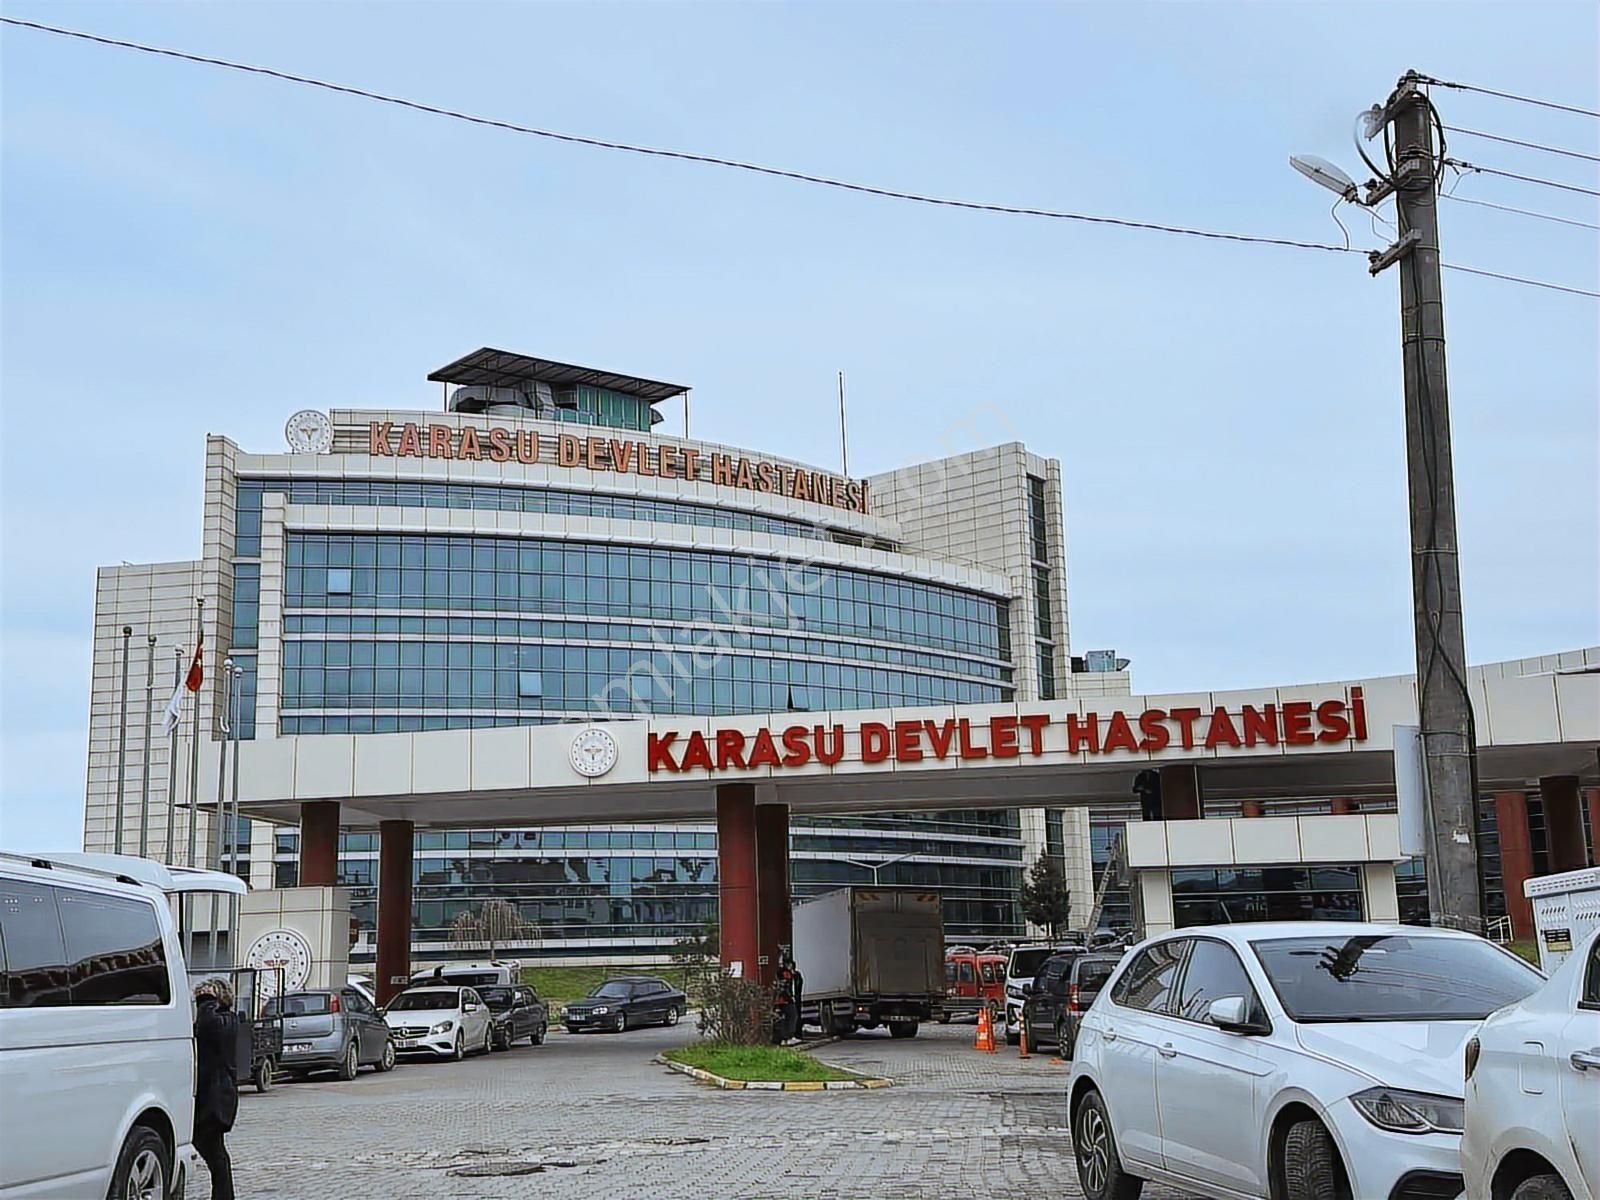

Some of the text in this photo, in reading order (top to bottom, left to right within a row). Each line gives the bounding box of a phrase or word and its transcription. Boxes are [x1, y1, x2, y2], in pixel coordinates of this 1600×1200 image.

[369, 421, 540, 464] KARASU
[558, 433, 700, 481] DEVLET
[711, 452, 871, 515] HASTANESİ
[648, 724, 845, 772] KARASU
[860, 714, 1050, 763] DEVLET
[1067, 687, 1366, 754] HASTANESİ
